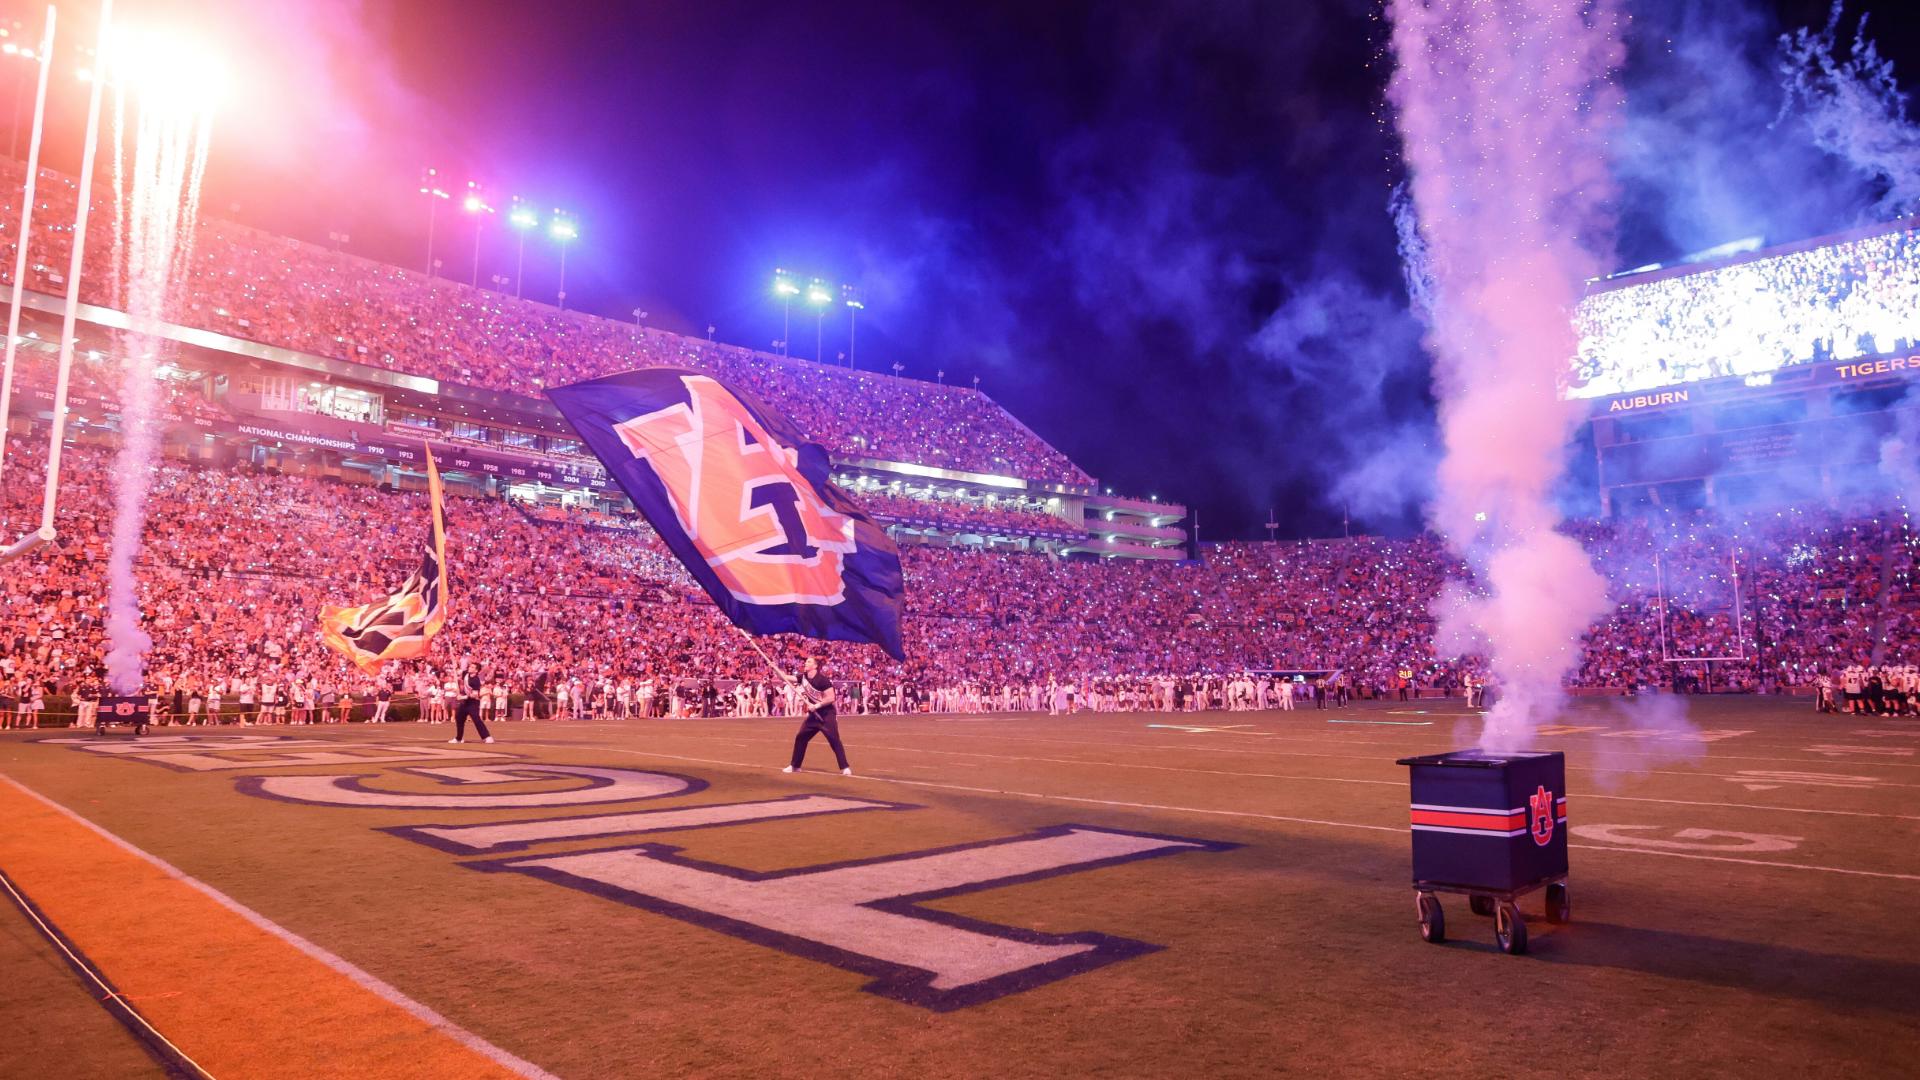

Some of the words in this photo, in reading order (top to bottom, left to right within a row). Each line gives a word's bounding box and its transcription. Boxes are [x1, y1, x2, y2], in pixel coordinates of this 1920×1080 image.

[1835, 355, 1920, 378] TIGERS
[1609, 390, 1689, 412] AUBURN
[194, 418, 213, 427] 2010
[238, 425, 285, 439] NATIONAL
[285, 432, 356, 450] CHAMPIONSHIPS
[368, 446, 385, 455] 1910
[399, 451, 414, 459] 1913
[455, 459, 471, 468] 1957
[590, 479, 606, 487] 2010
